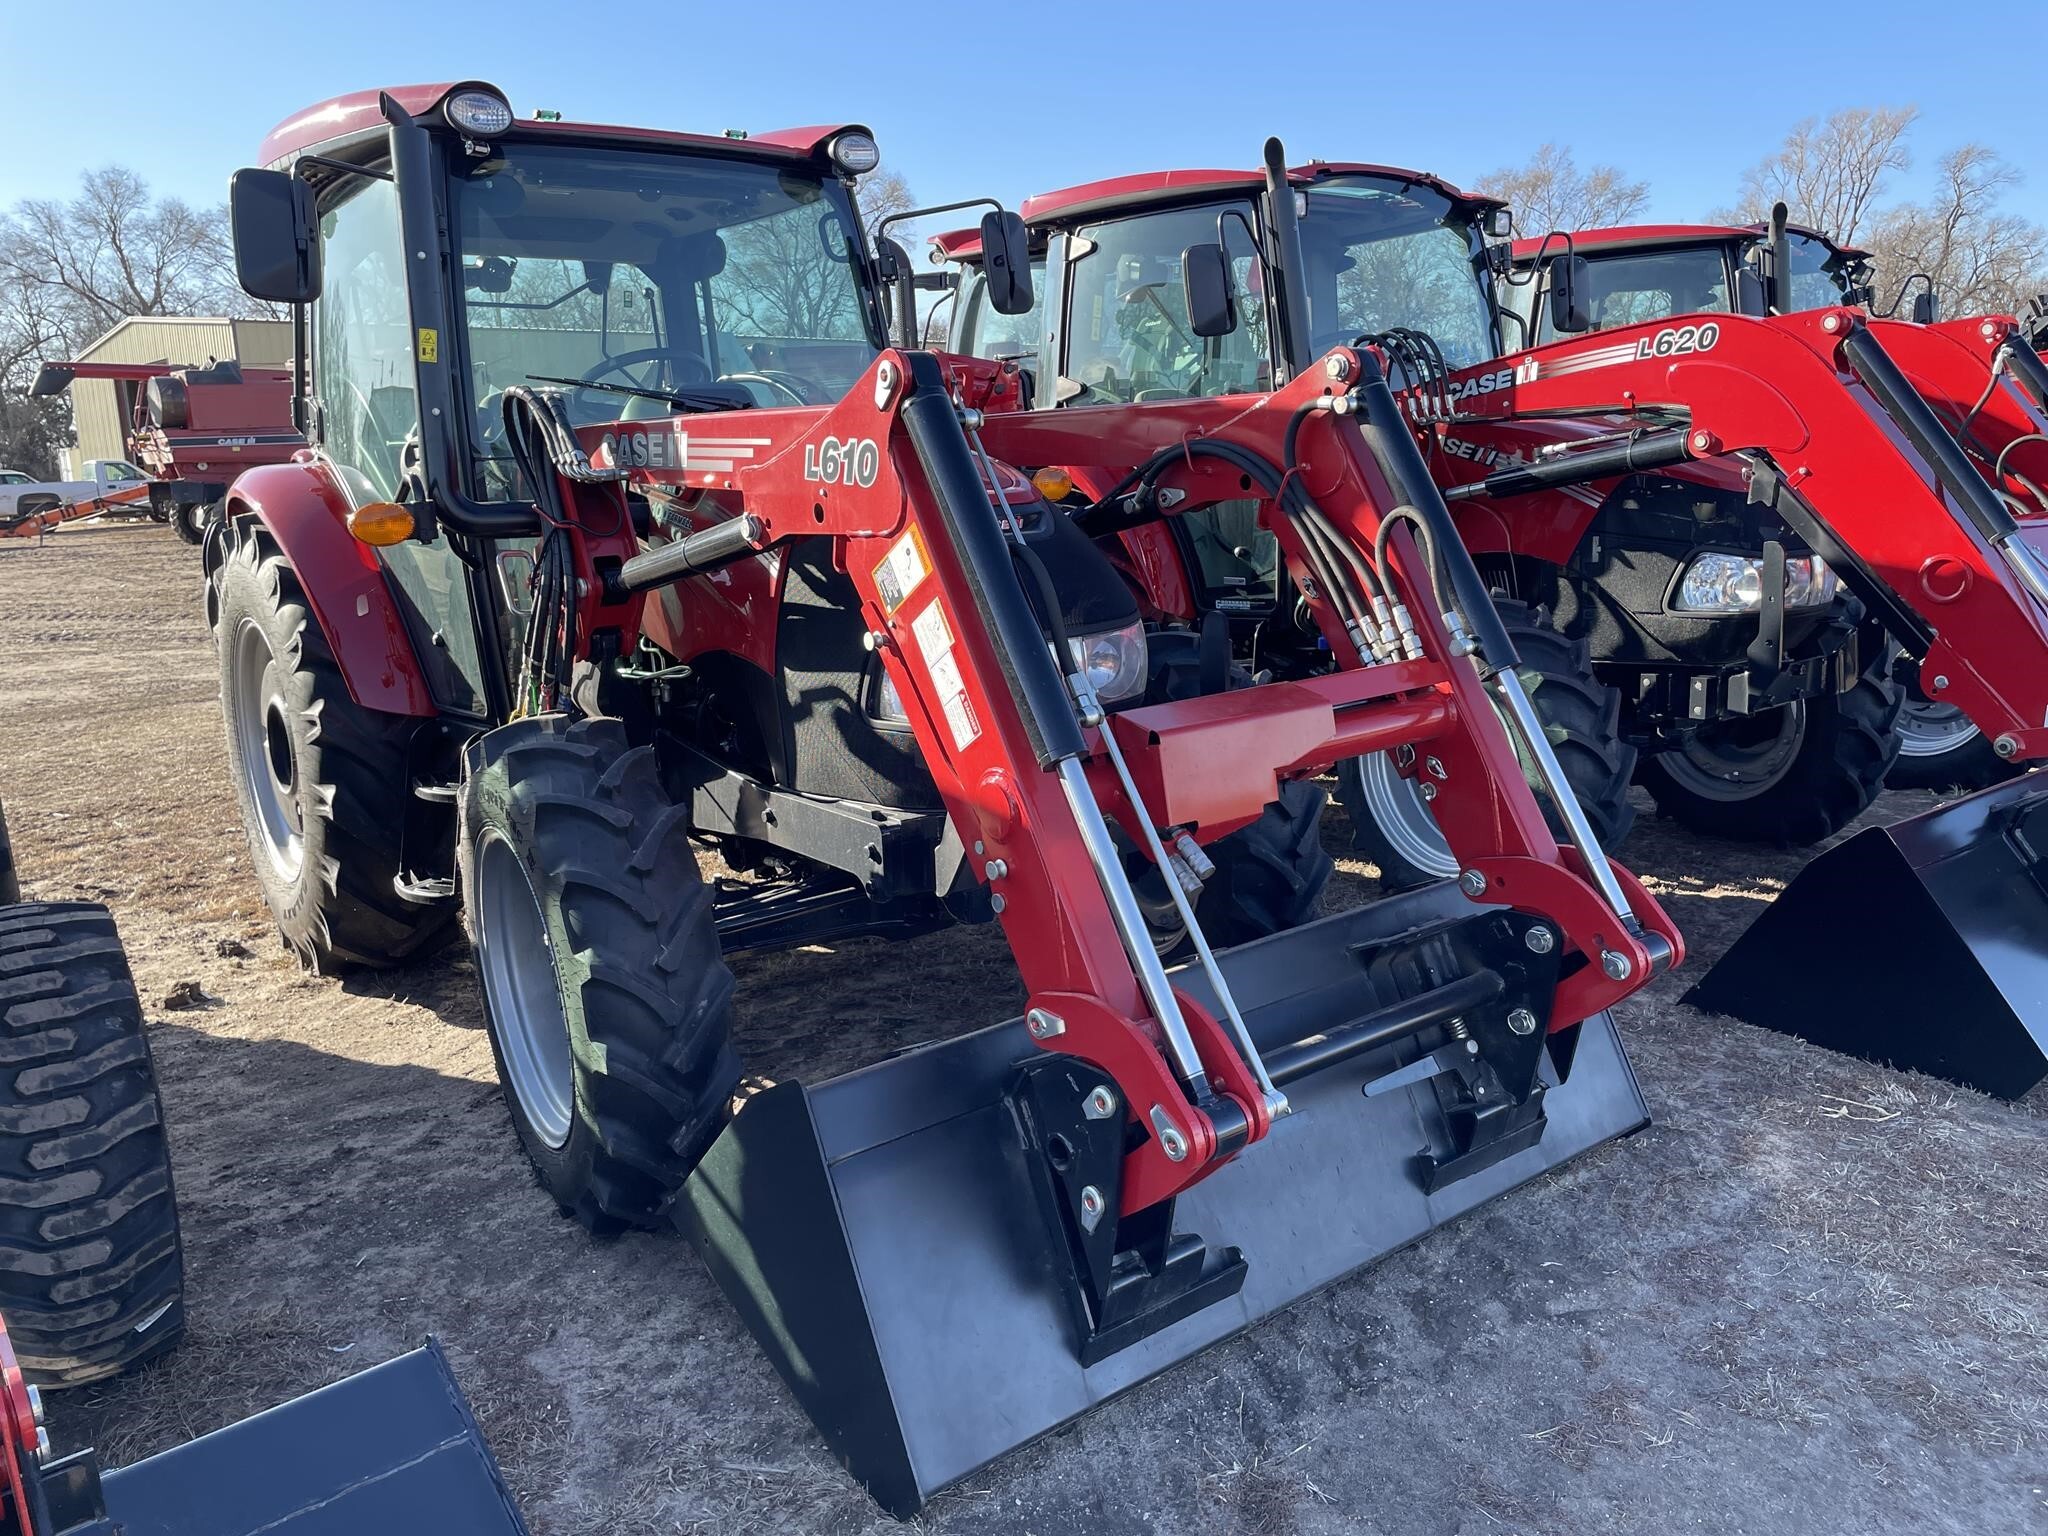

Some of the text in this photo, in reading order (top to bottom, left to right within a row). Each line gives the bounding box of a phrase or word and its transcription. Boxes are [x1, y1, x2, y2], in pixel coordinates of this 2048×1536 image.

[1636, 323, 1719, 360] L620
[1449, 368, 1512, 401] CASE
[217, 438, 246, 446] CASE
[601, 432, 663, 467] CASE
[805, 436, 879, 488] L610
[963, 701, 978, 733] DANGER
